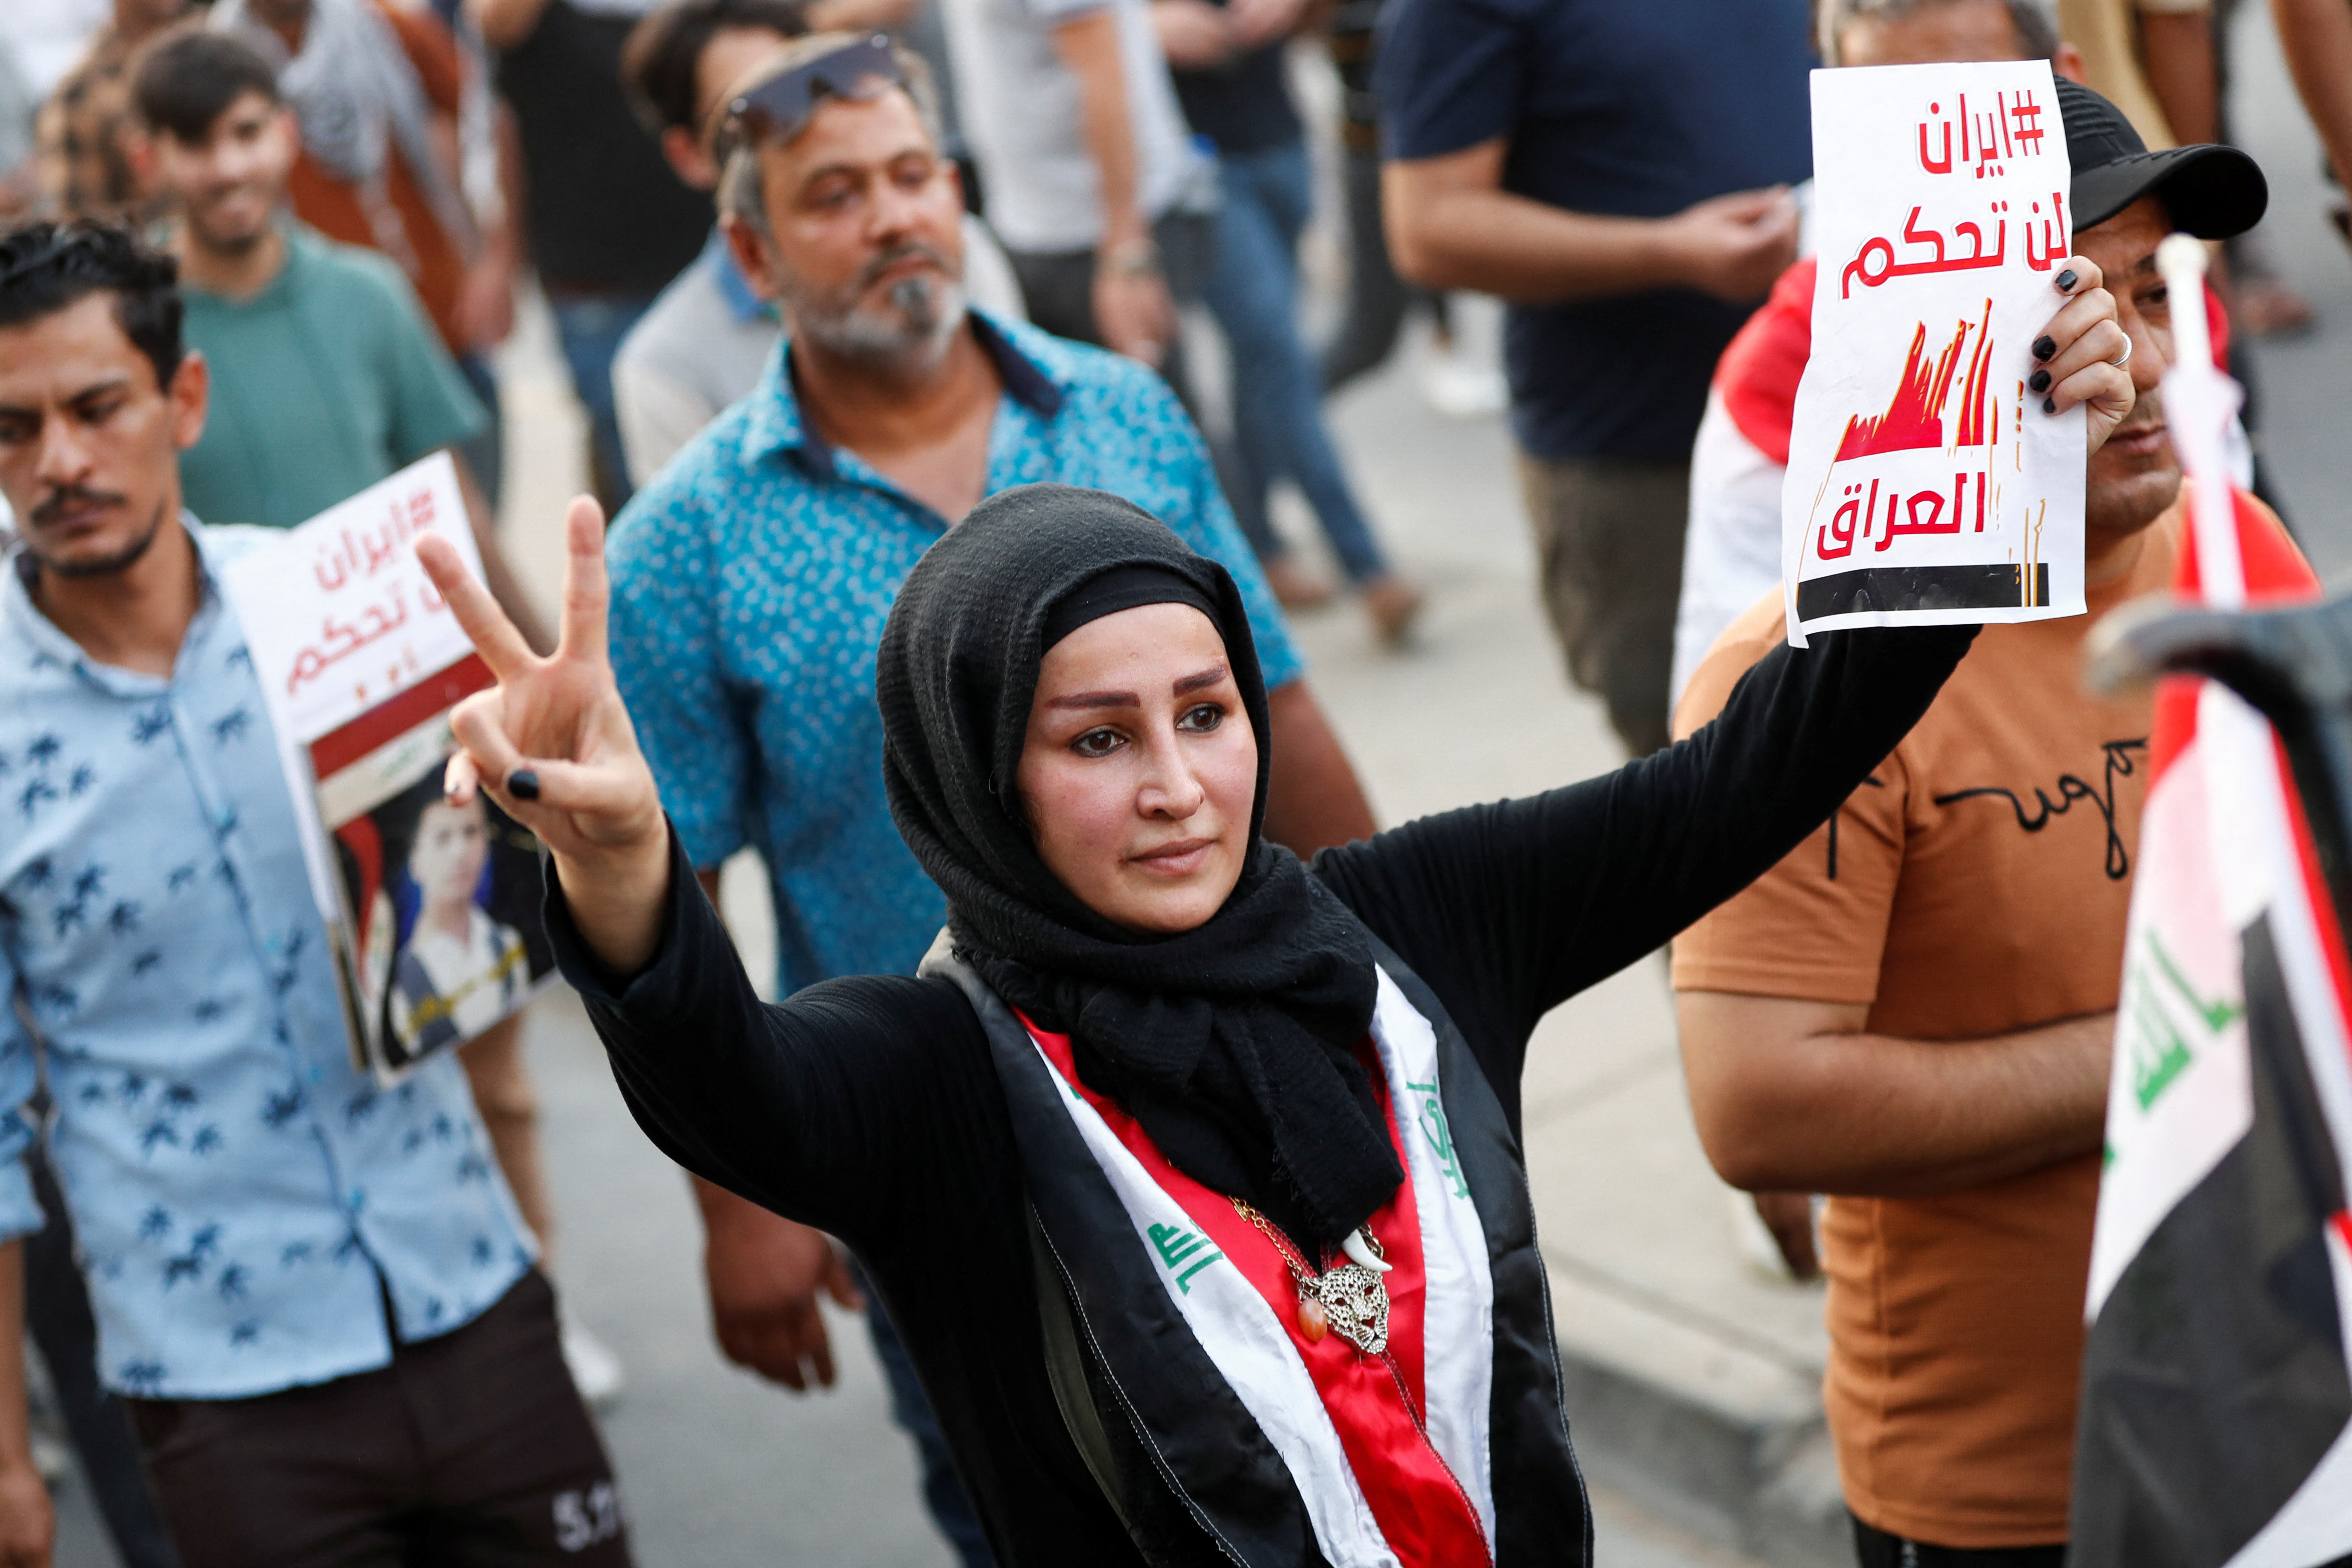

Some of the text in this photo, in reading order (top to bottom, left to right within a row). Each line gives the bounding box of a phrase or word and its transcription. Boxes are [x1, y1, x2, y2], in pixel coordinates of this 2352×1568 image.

[1919, 89, 2044, 179] #ايران
[1842, 192, 2068, 300] لن تحكم
[314, 487, 438, 592] #ايران
[1817, 472, 1985, 561] العراق
[287, 578, 409, 694] تحكم
